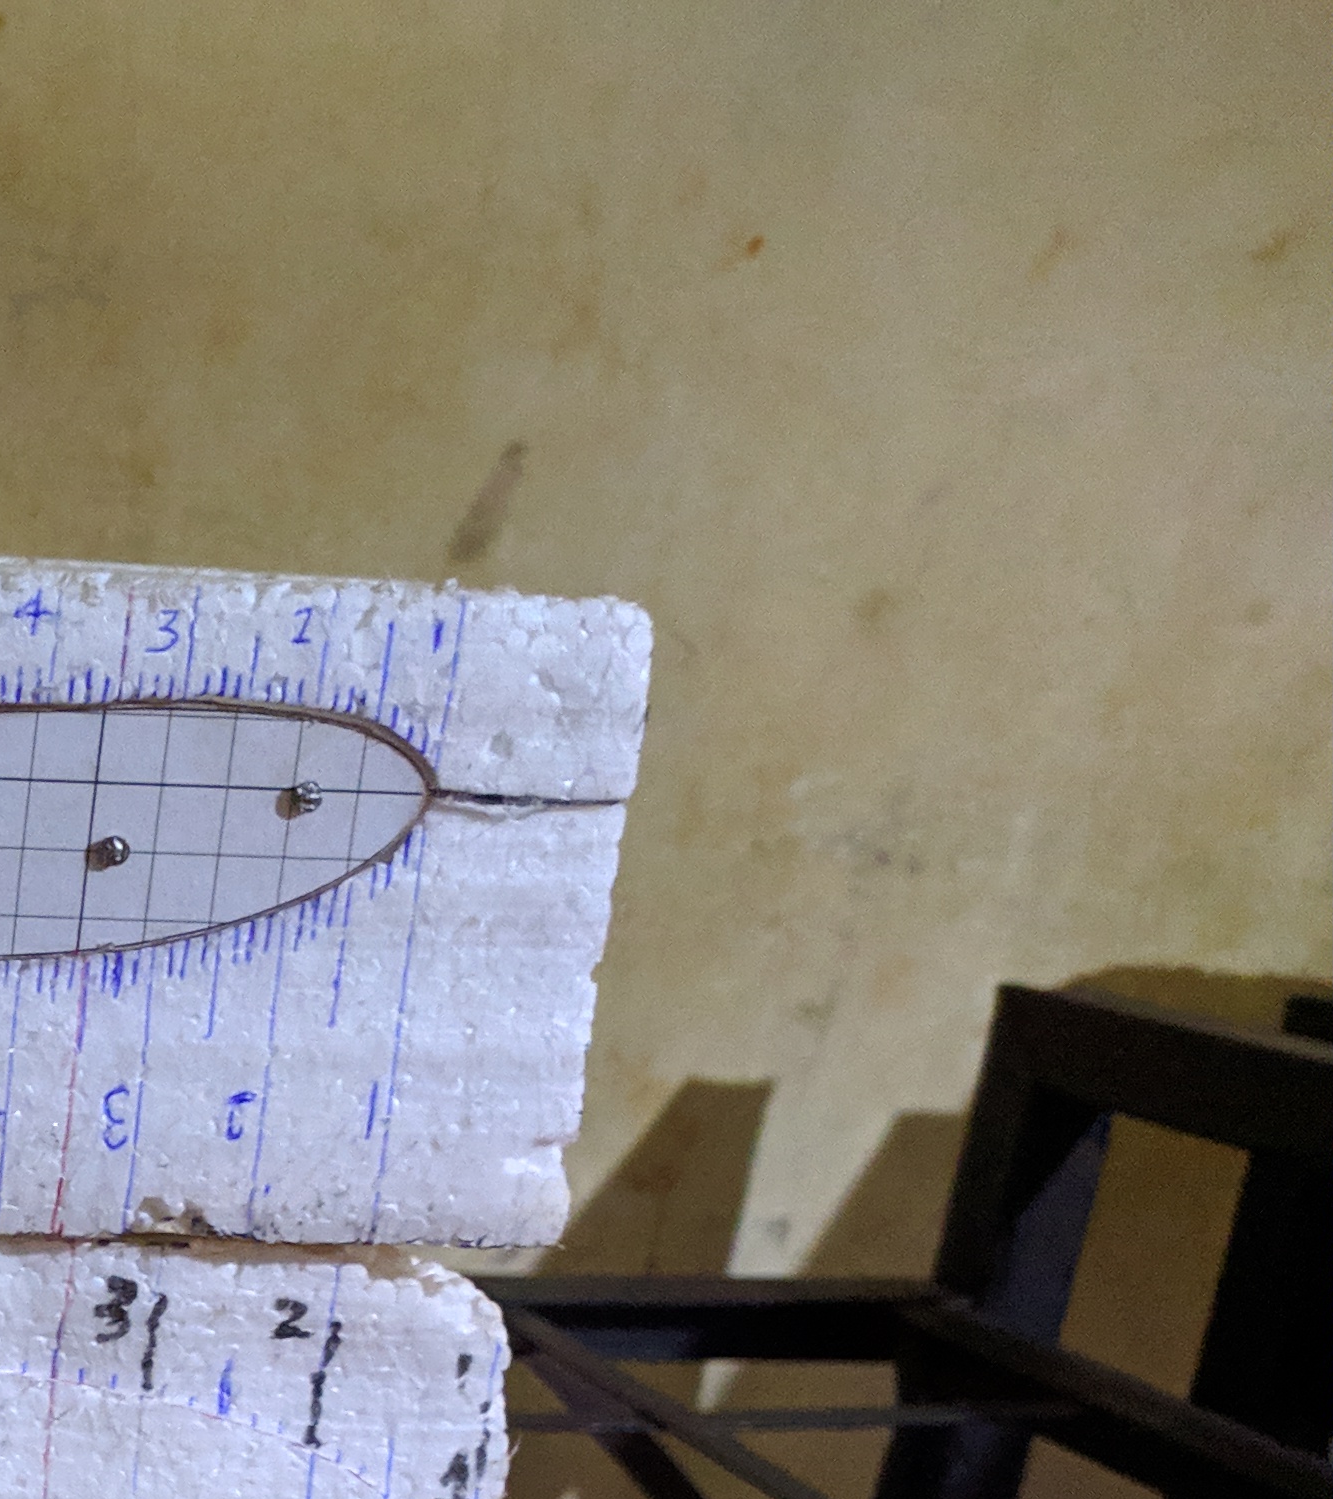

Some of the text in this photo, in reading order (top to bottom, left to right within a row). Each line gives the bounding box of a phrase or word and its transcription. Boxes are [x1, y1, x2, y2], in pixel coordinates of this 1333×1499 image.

[14, 587, 60, 635] 4
[145, 608, 180, 653] 3
[291, 607, 320, 645] 2
[102, 1083, 131, 1151] 3
[93, 1275, 139, 1344] 3
[269, 1297, 315, 1340] 2
